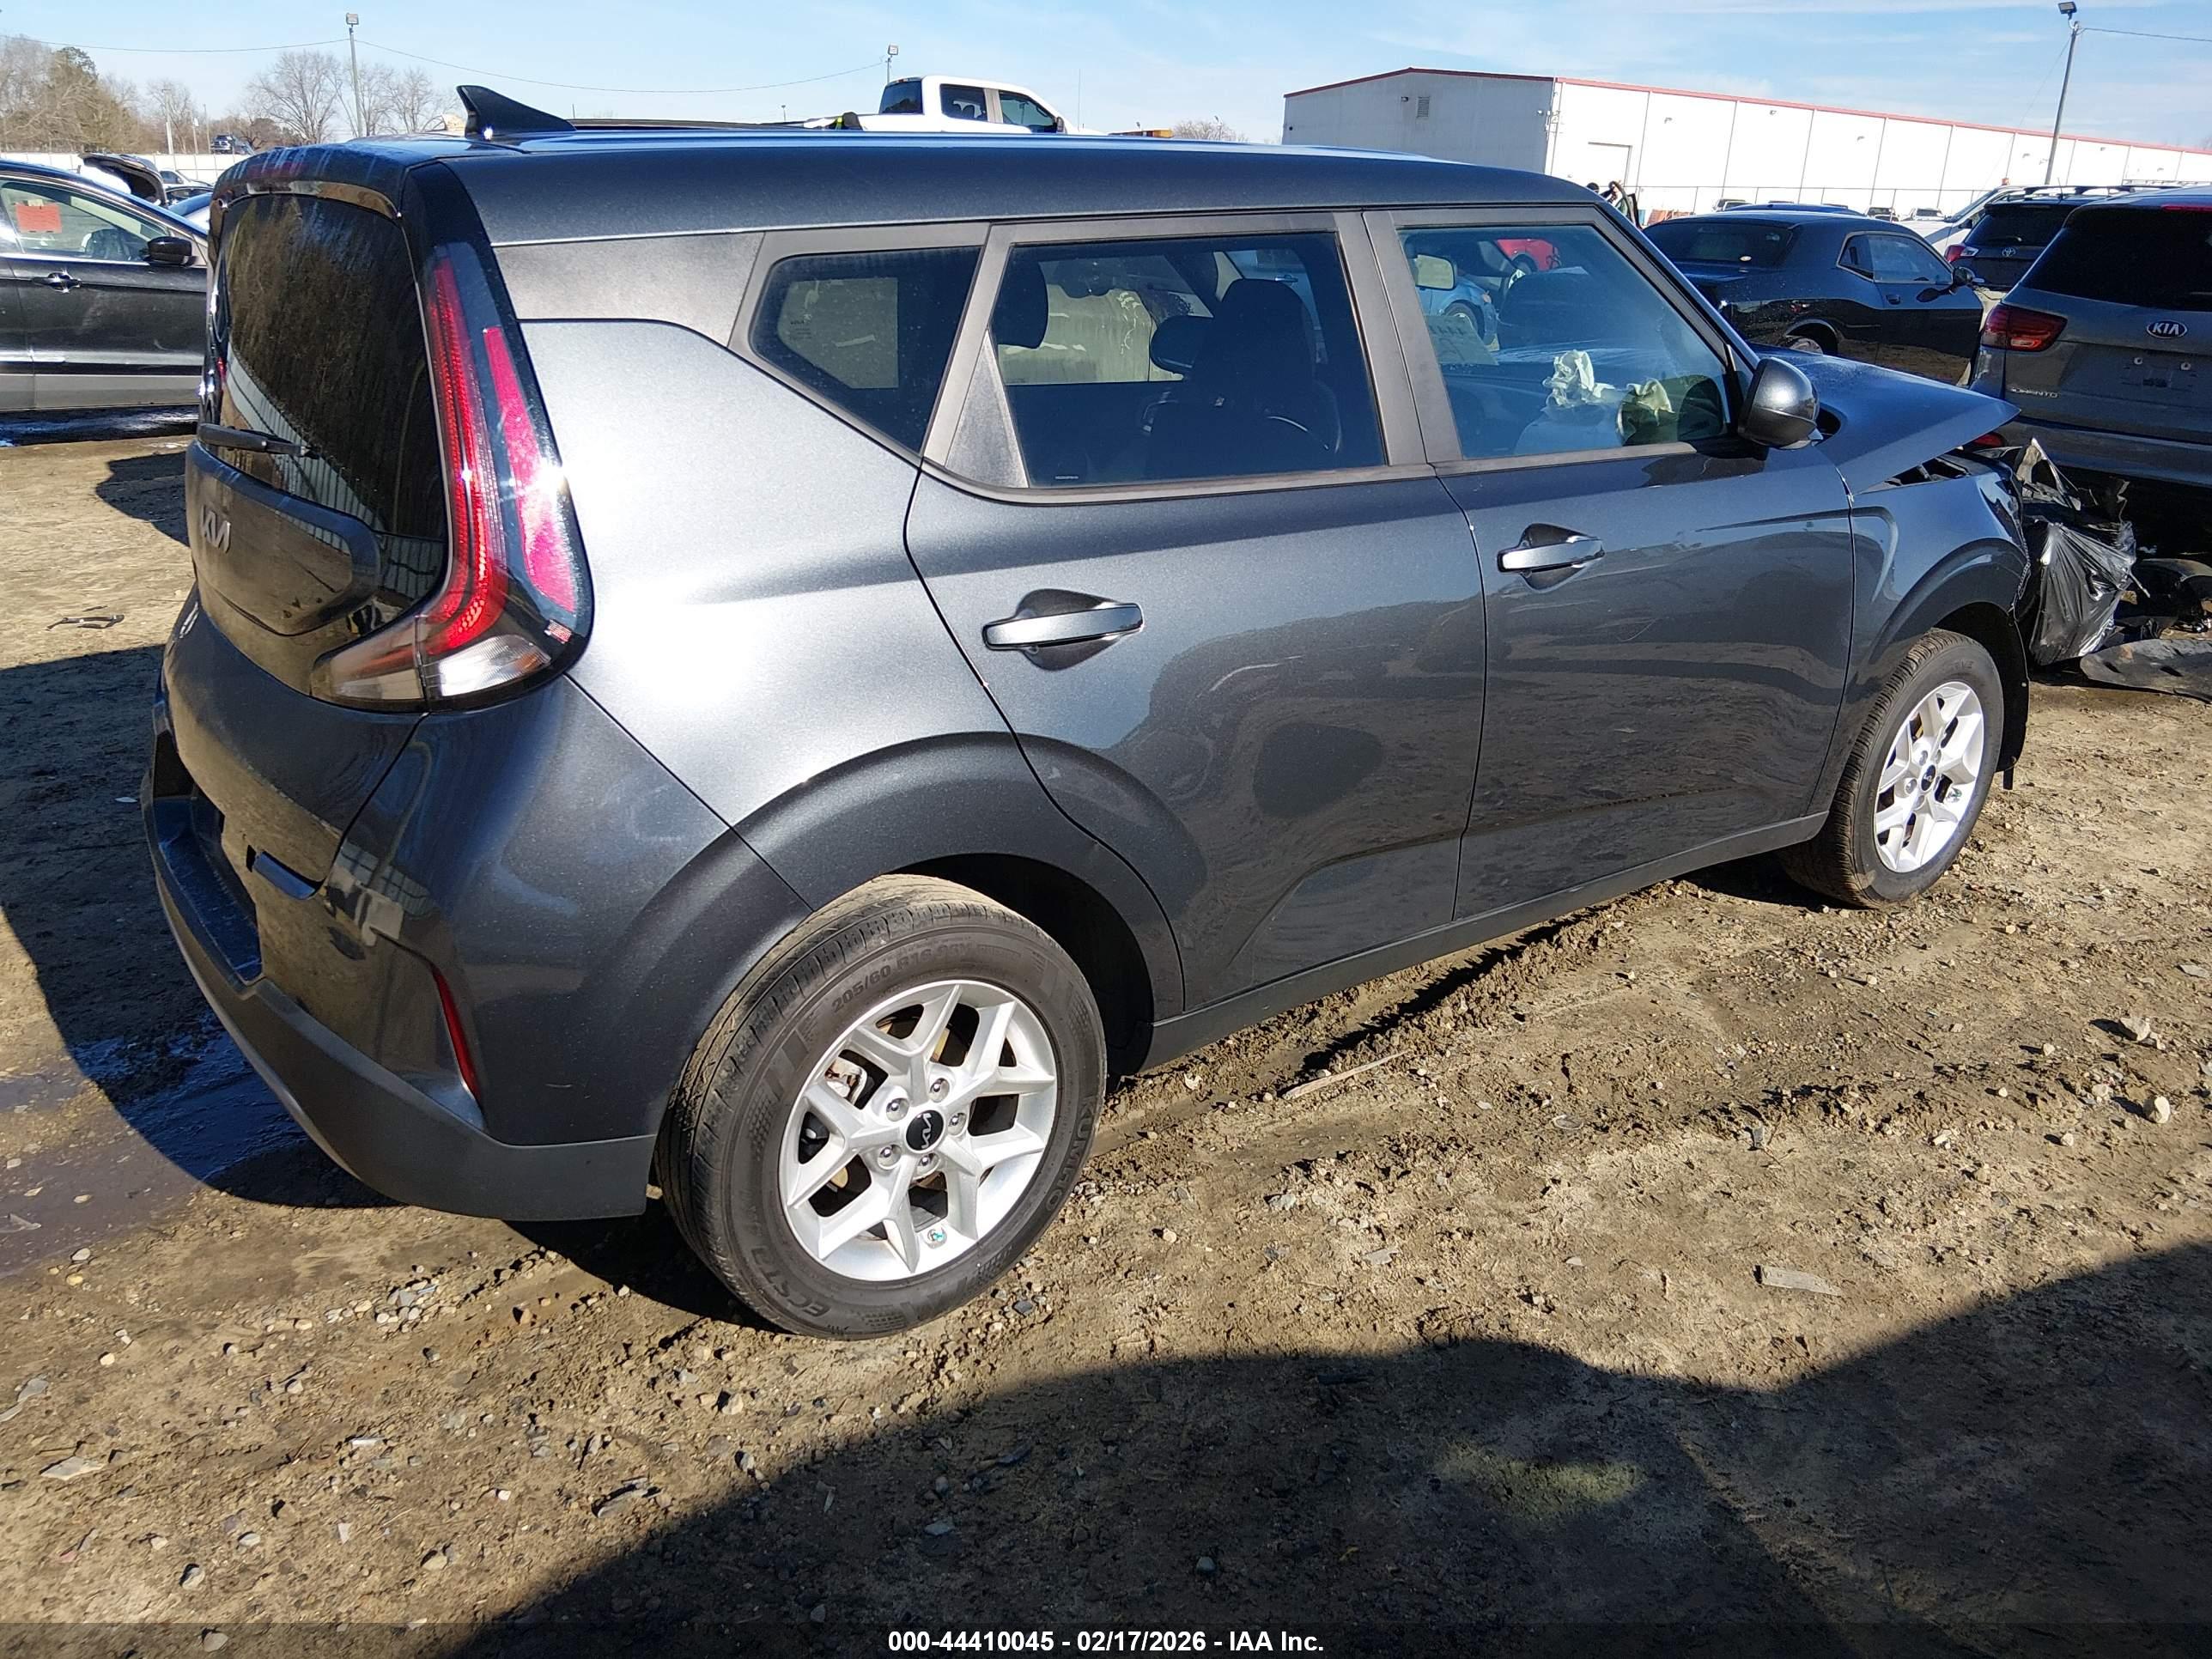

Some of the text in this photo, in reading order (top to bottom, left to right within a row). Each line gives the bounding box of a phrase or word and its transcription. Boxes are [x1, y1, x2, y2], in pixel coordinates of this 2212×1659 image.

[2151, 321, 2179, 336] KIA
[830, 966, 891, 1013] 205/60
[1044, 1096, 1097, 1212] KUMHO
